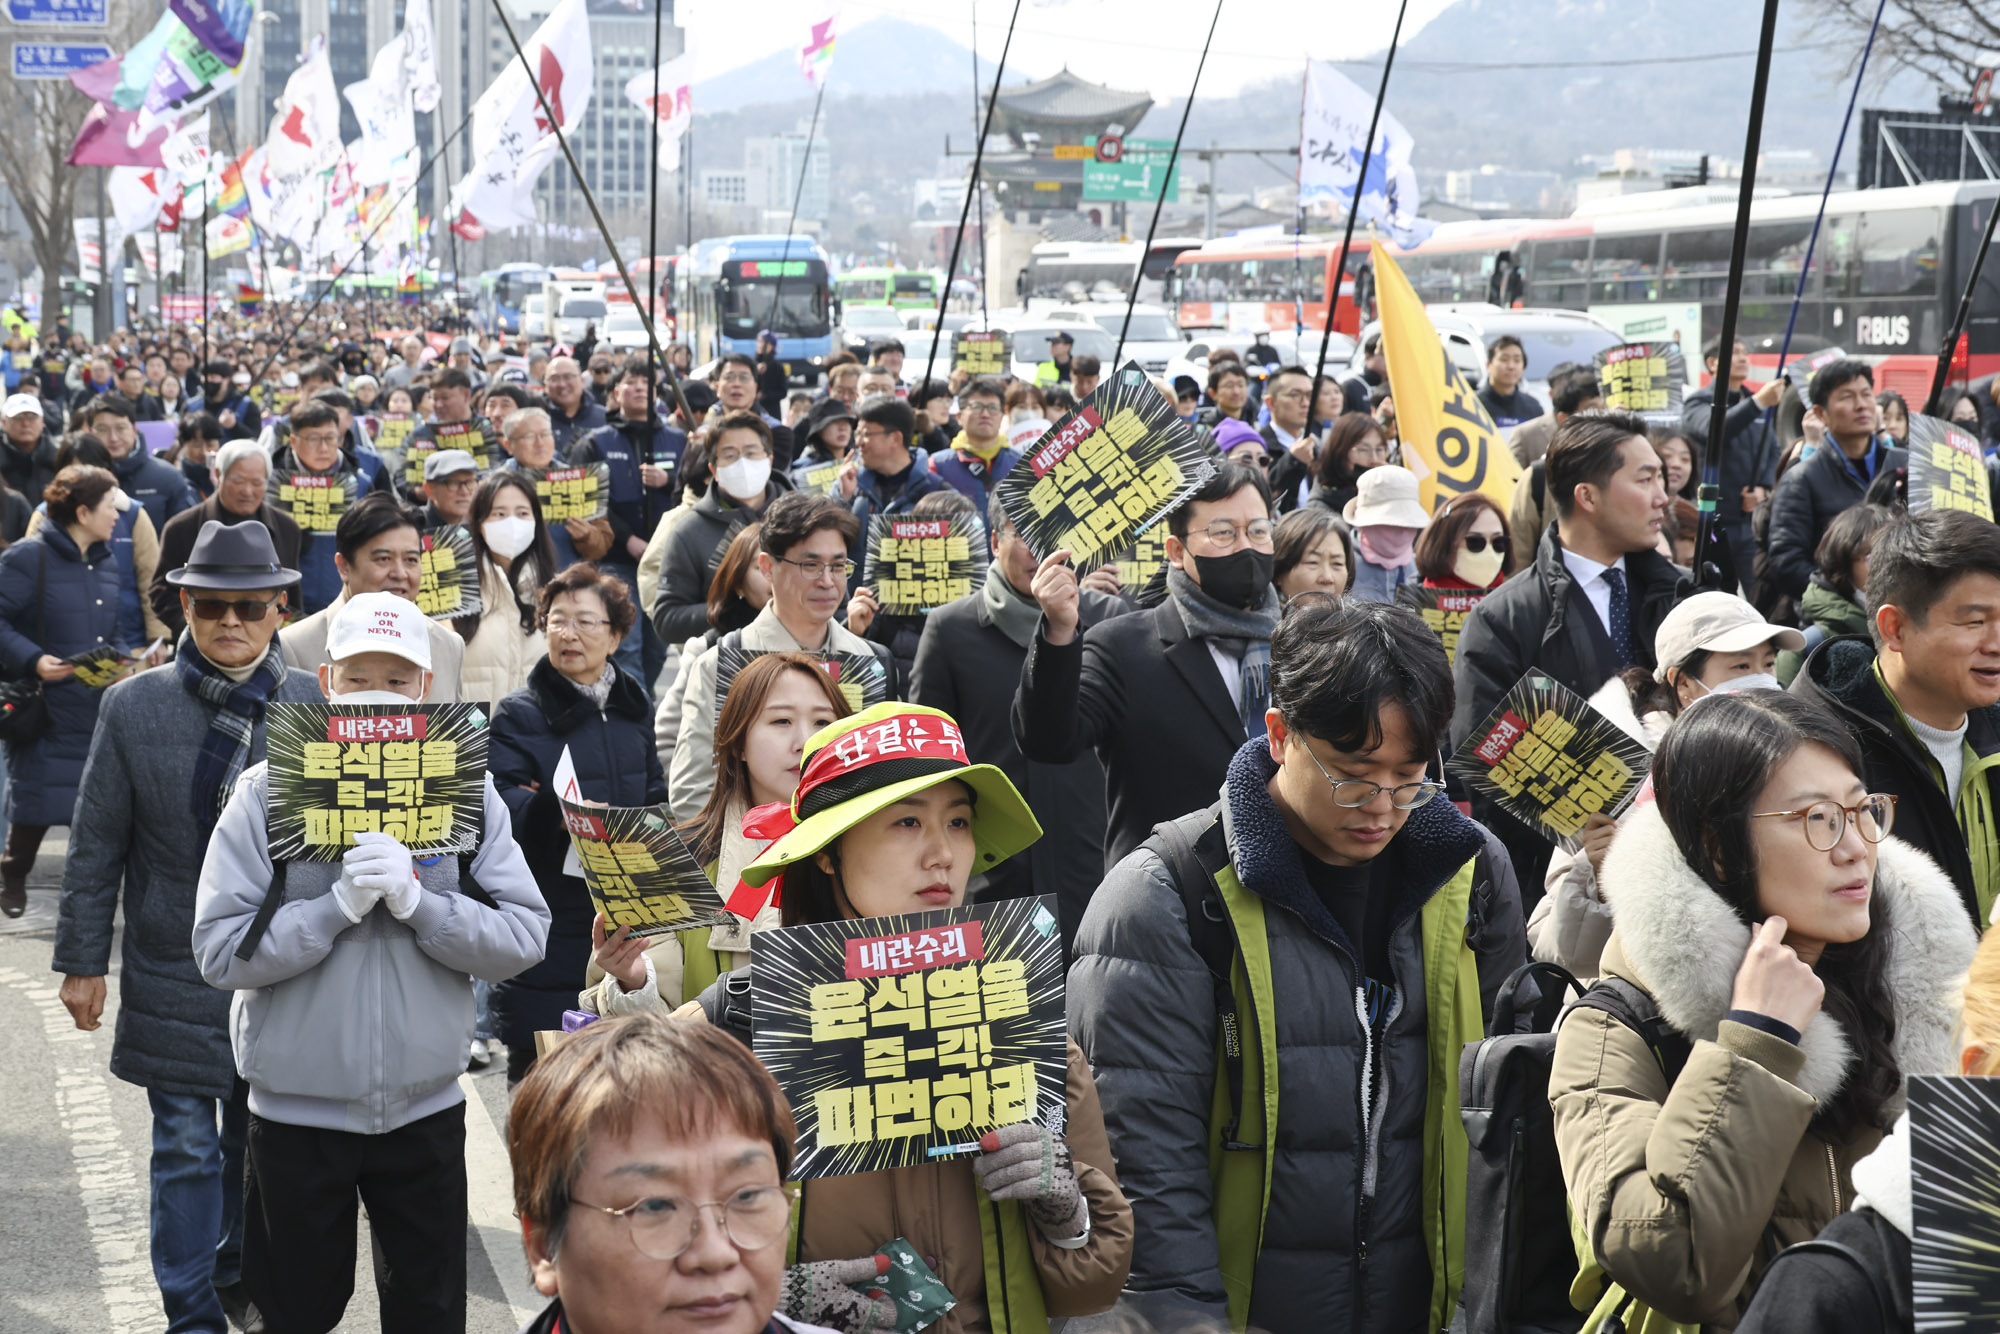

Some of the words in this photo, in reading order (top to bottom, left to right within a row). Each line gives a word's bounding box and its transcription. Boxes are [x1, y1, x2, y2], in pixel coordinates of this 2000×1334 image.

[1028, 407, 1149, 520] 윤석열을
[1036, 415, 1092, 470] 내란수괴
[1064, 452, 1140, 520] 즉-각!
[896, 522, 940, 537] 내란수괴
[1057, 454, 1187, 567] 파면하라
[879, 535, 970, 562] 윤석열을
[878, 578, 972, 605] 파면하라
[367, 627, 402, 639] NEVER
[374, 611, 400, 619] NOW
[378, 619, 394, 628] OR
[337, 716, 414, 739] 내란수괴
[835, 718, 907, 768] 단결
[303, 740, 457, 780] 윤석열을
[1487, 709, 1578, 799] 윤석열을
[337, 779, 425, 808] 즉-각!
[1540, 749, 1636, 838] 파면하라
[303, 804, 454, 845] 파면하라
[859, 926, 968, 972] 내란수괴
[809, 958, 1030, 1044] 윤석열을
[863, 1023, 994, 1079] 즉-각!
[1227, 1012, 1240, 1058] OUTDOORS
[813, 1061, 1038, 1149] 파면하라
